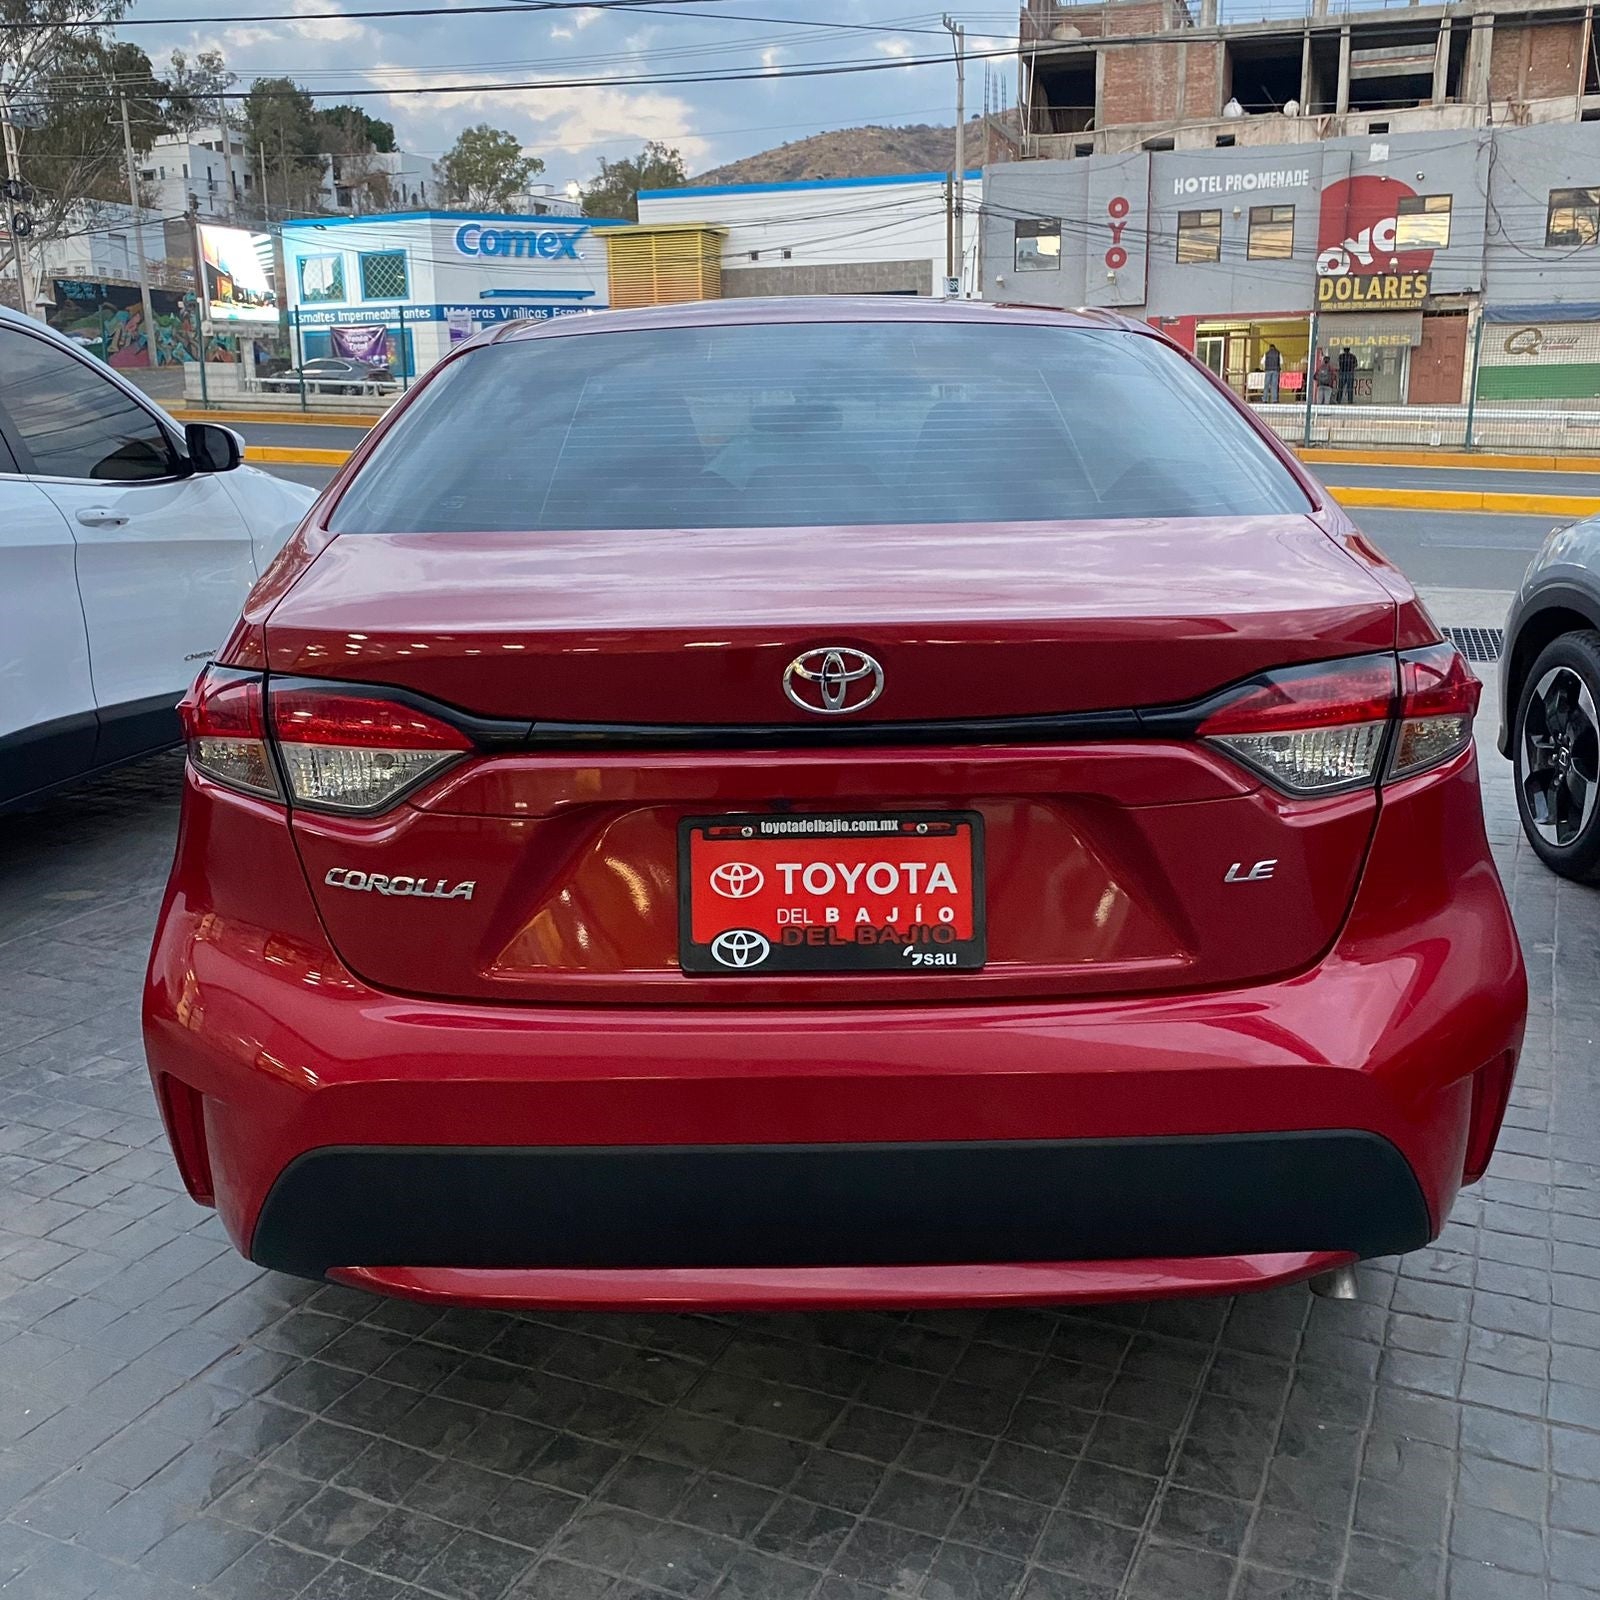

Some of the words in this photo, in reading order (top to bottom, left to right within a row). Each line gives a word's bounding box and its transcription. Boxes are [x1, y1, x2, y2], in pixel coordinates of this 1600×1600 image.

[1173, 176, 1223, 195] HOTEL
[1225, 169, 1310, 192] PROMENADE
[455, 222, 590, 260] Comex
[1105, 196, 1130, 269] OYO
[1328, 335, 1411, 347] DOLARES
[760, 818, 899, 834] toyotadelbajio.com.mx
[324, 867, 477, 900] COROLLA
[775, 862, 958, 895] TOYOTA
[1224, 859, 1278, 883] LE
[776, 908, 813, 924] DEL
[781, 925, 848, 946] DEL
[855, 924, 957, 946] BAJIO
